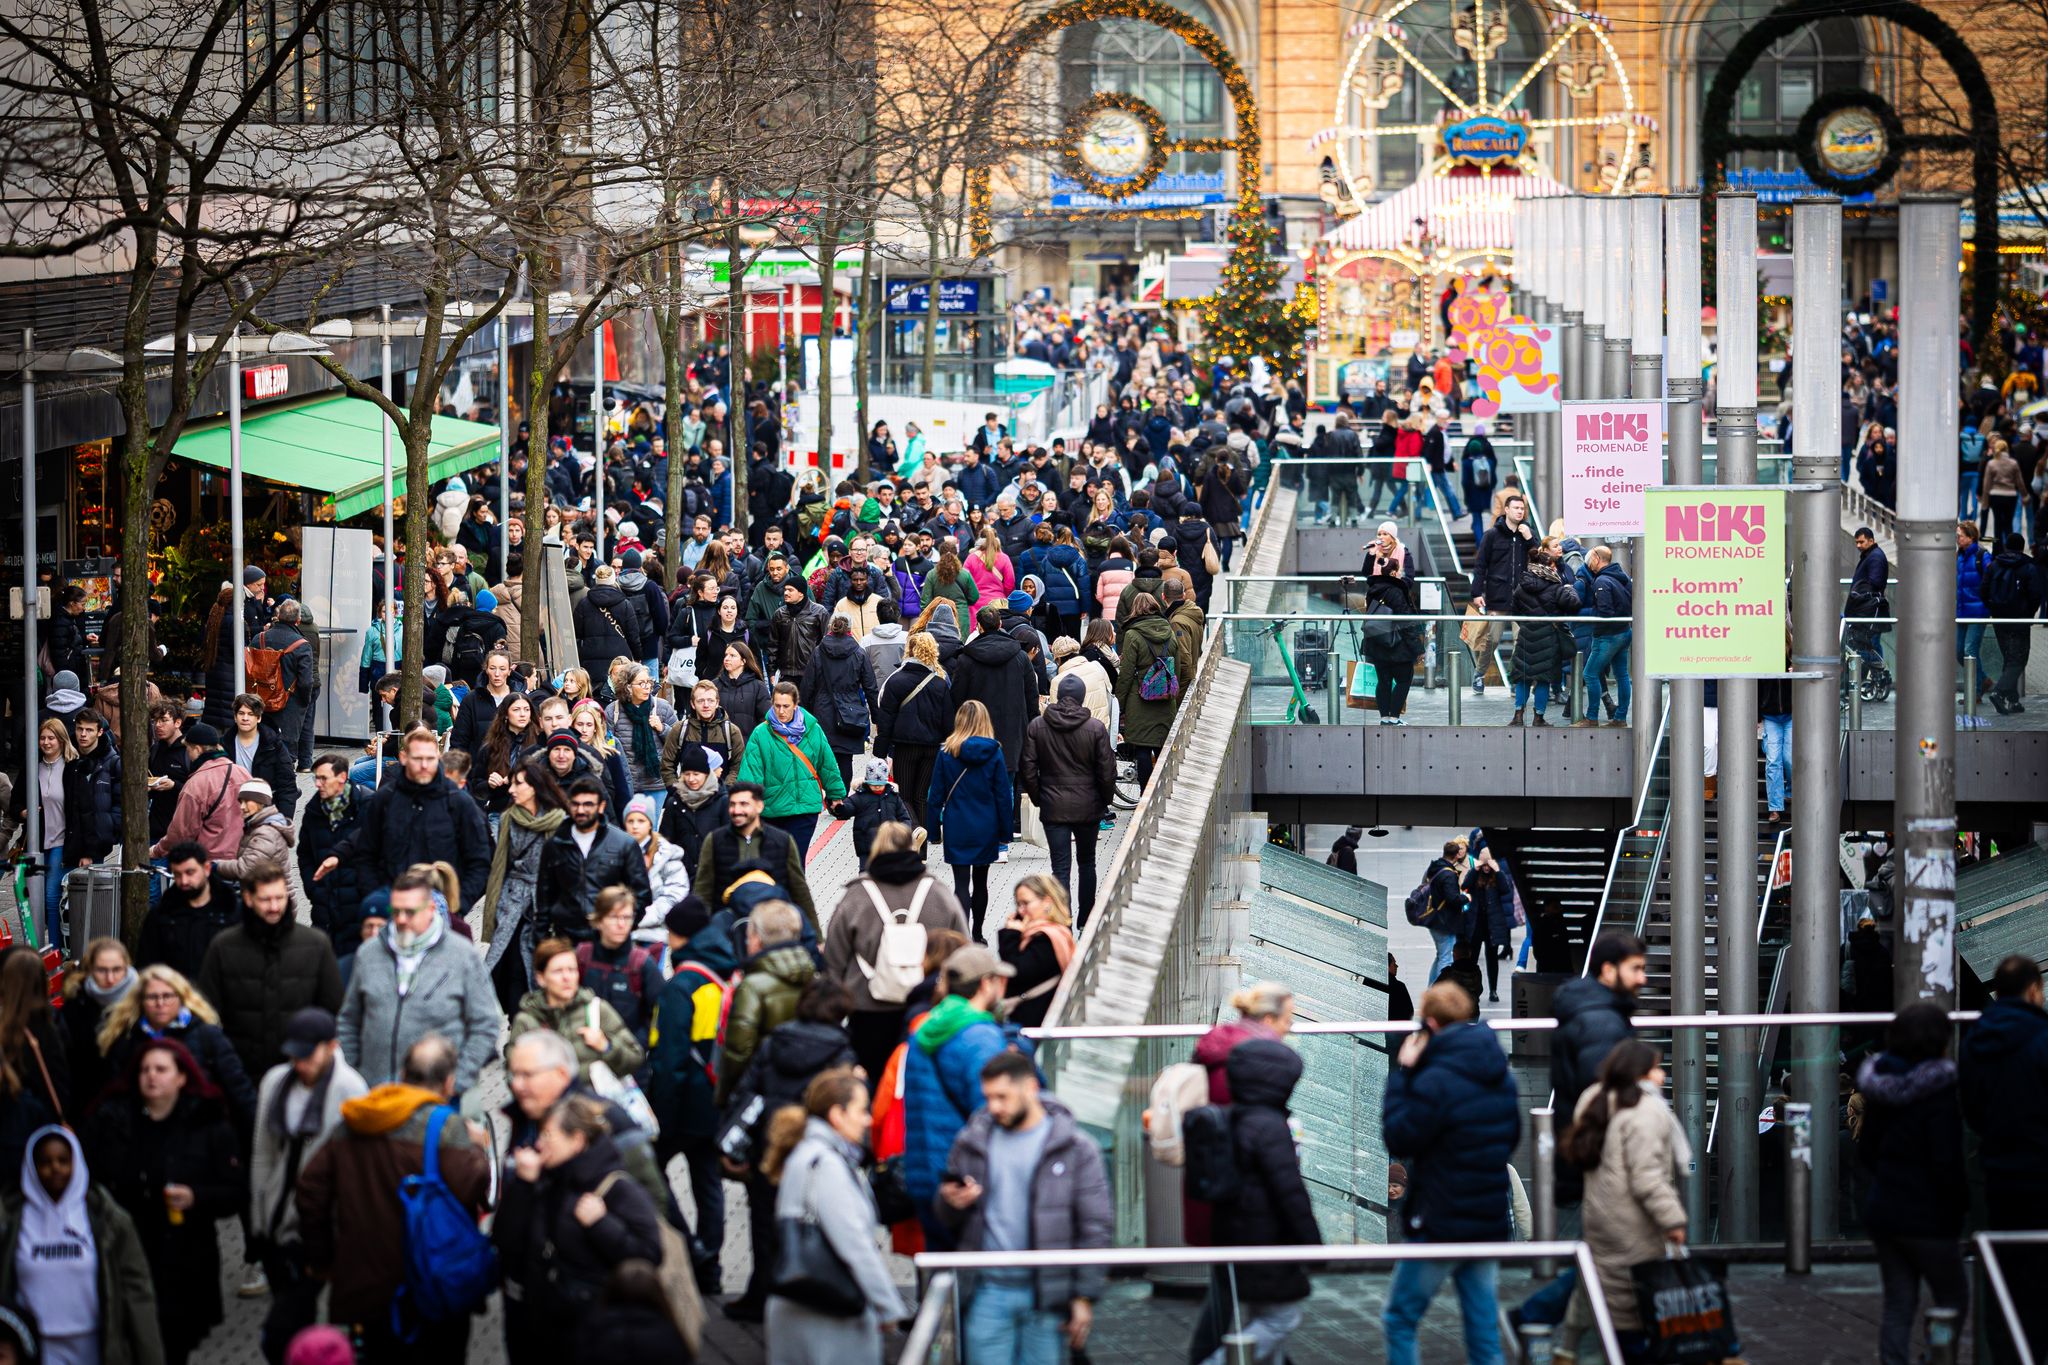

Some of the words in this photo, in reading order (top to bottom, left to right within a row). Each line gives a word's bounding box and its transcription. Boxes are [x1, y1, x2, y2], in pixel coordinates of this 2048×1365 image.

[1577, 443, 1648, 453] PROMENADE
[1584, 497, 1621, 513] Style
[1665, 546, 1766, 559] PROMENADE
[1676, 600, 1728, 616] doch
[1734, 599, 1773, 616] mal
[1665, 624, 1731, 639] runter
[1679, 655, 1752, 663] niki-promenade.de
[31, 1243, 83, 1260] PUMA
